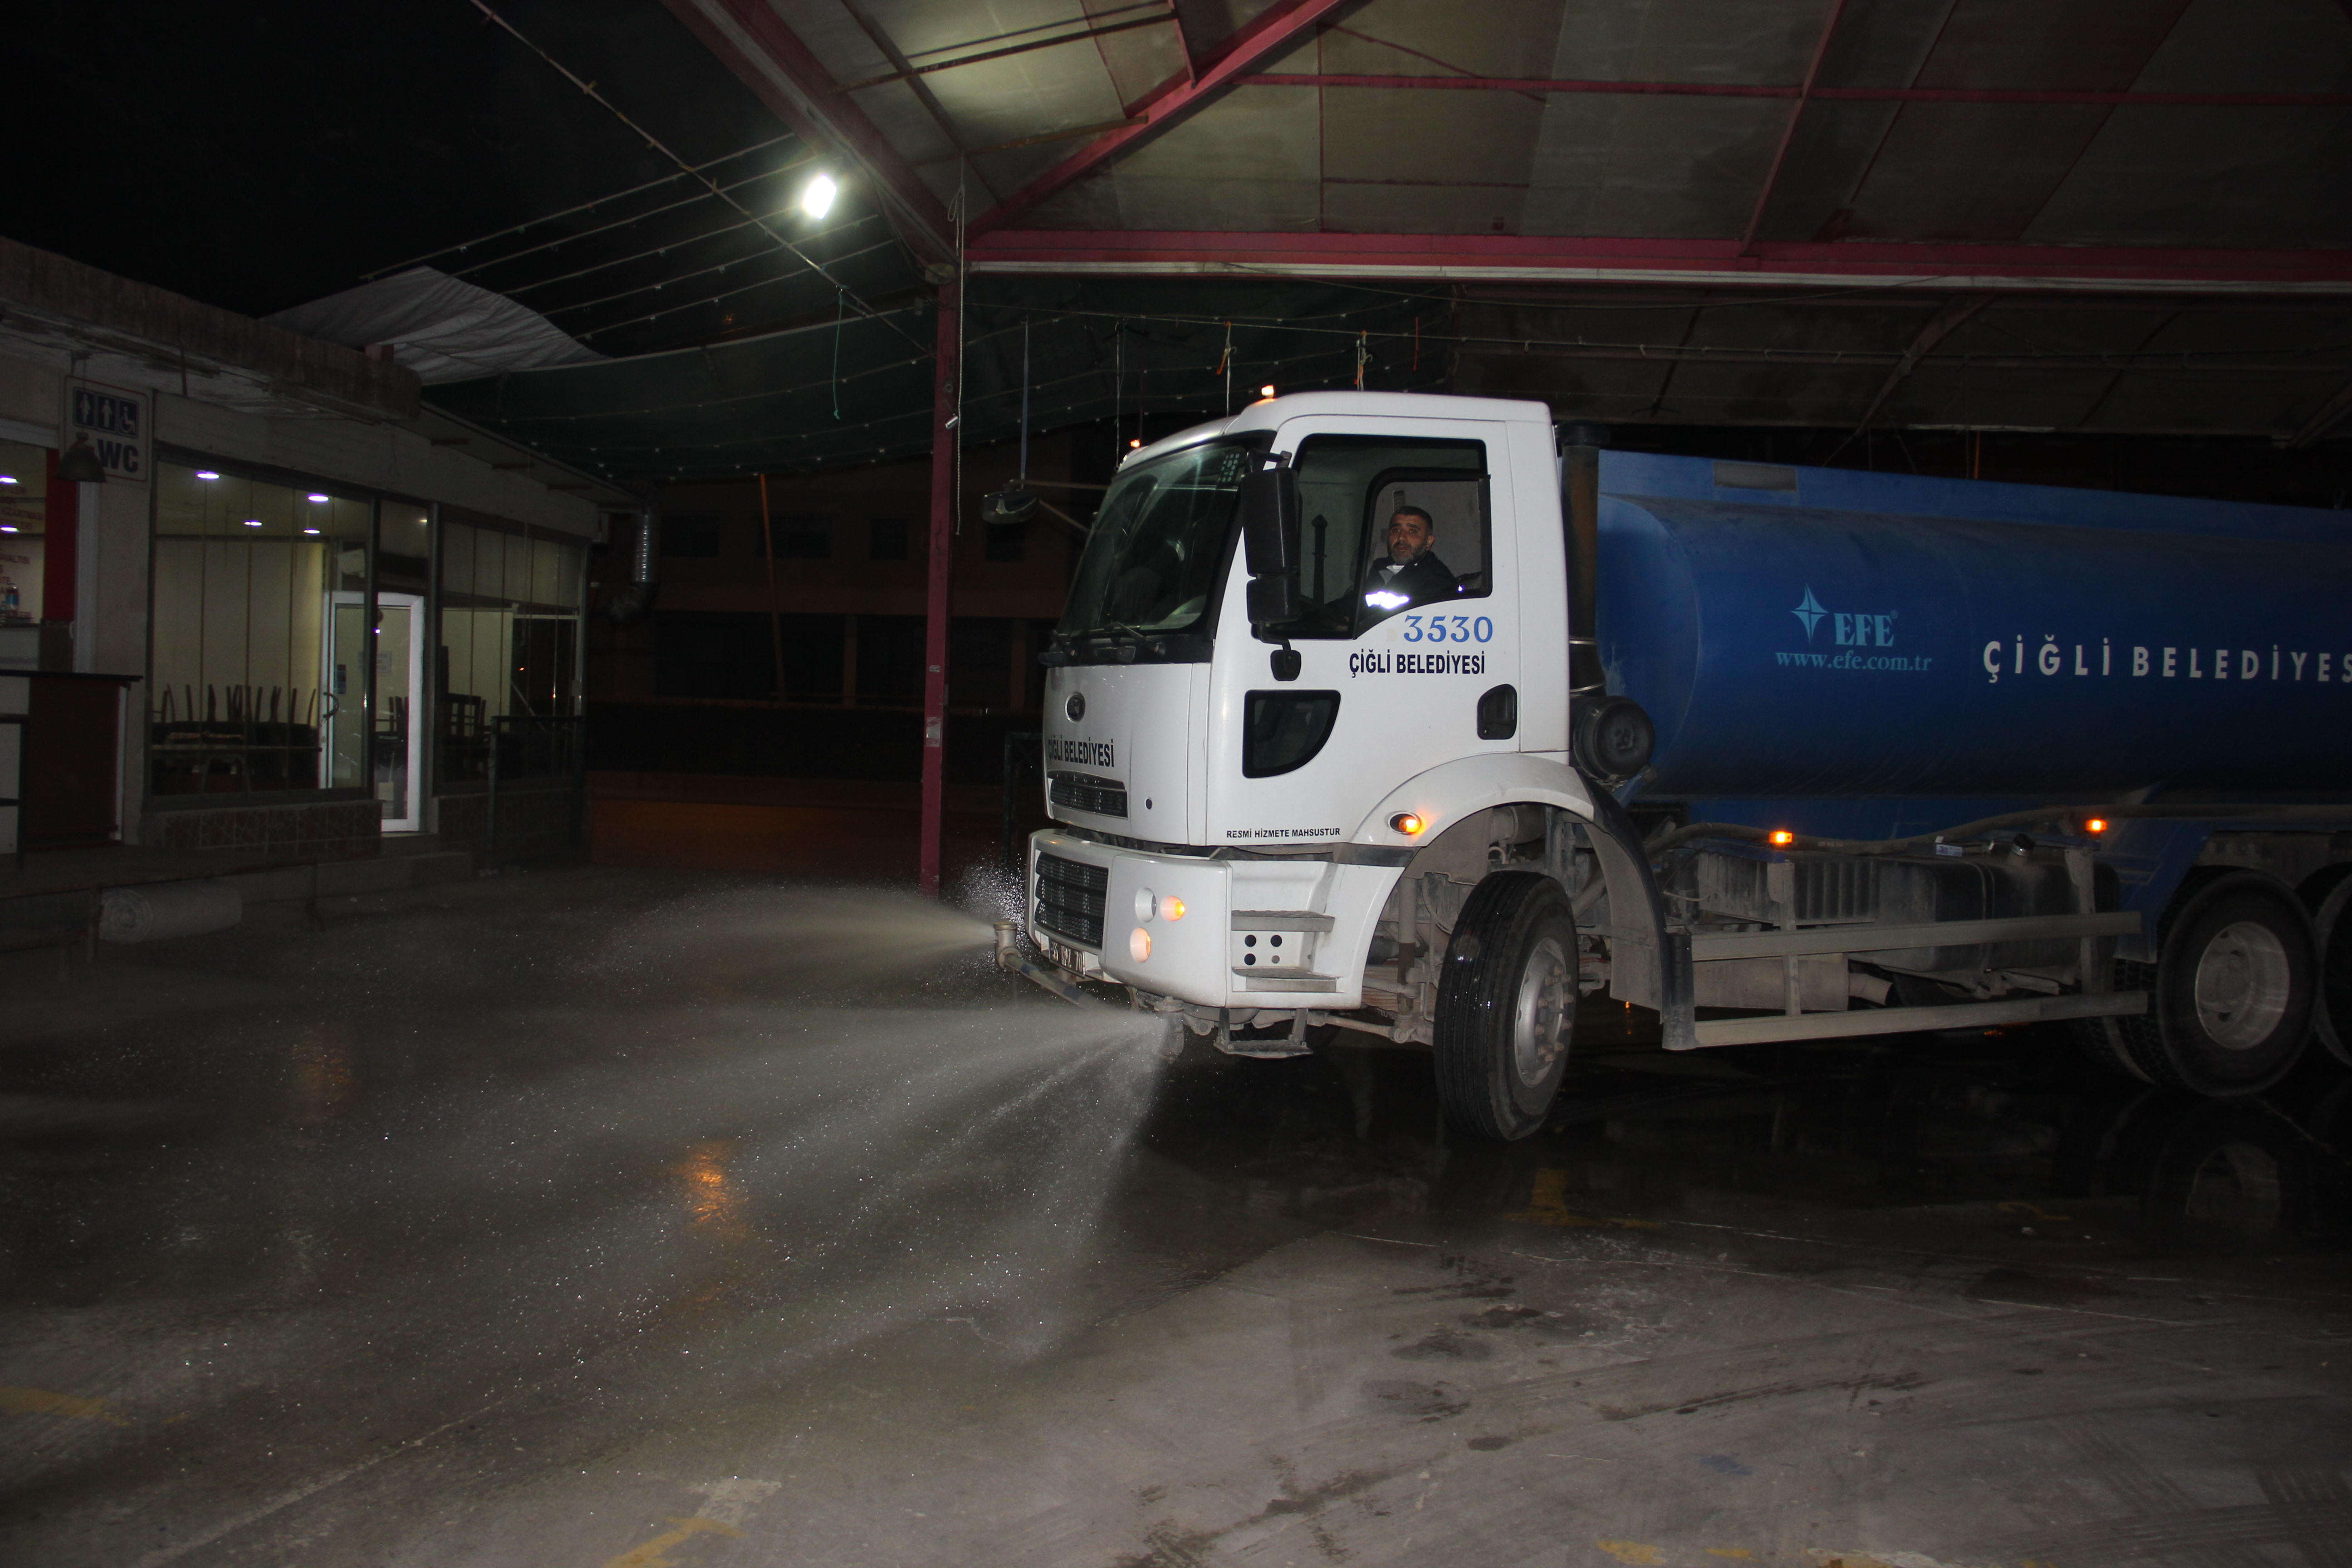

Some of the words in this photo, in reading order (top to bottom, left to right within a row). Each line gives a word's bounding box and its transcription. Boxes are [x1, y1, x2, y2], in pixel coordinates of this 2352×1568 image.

[97, 438, 139, 473] WC
[1404, 615, 1493, 642] 3530
[1834, 612, 1895, 647] EFE
[1349, 648, 1390, 678] ÇİĞLİ
[1396, 650, 1485, 674] BELEDİYESİ
[1775, 650, 1933, 671] www.efe.com.tr
[1983, 634, 2110, 683] ÇİĞLİ
[1048, 734, 1063, 764] ÇİĞLİ
[1064, 736, 1114, 768] BELEDİYESİ
[1226, 828, 1252, 838] RESMİ
[1254, 828, 1289, 838] HİZMETE
[1292, 828, 1341, 837] MAHSUSTUR
